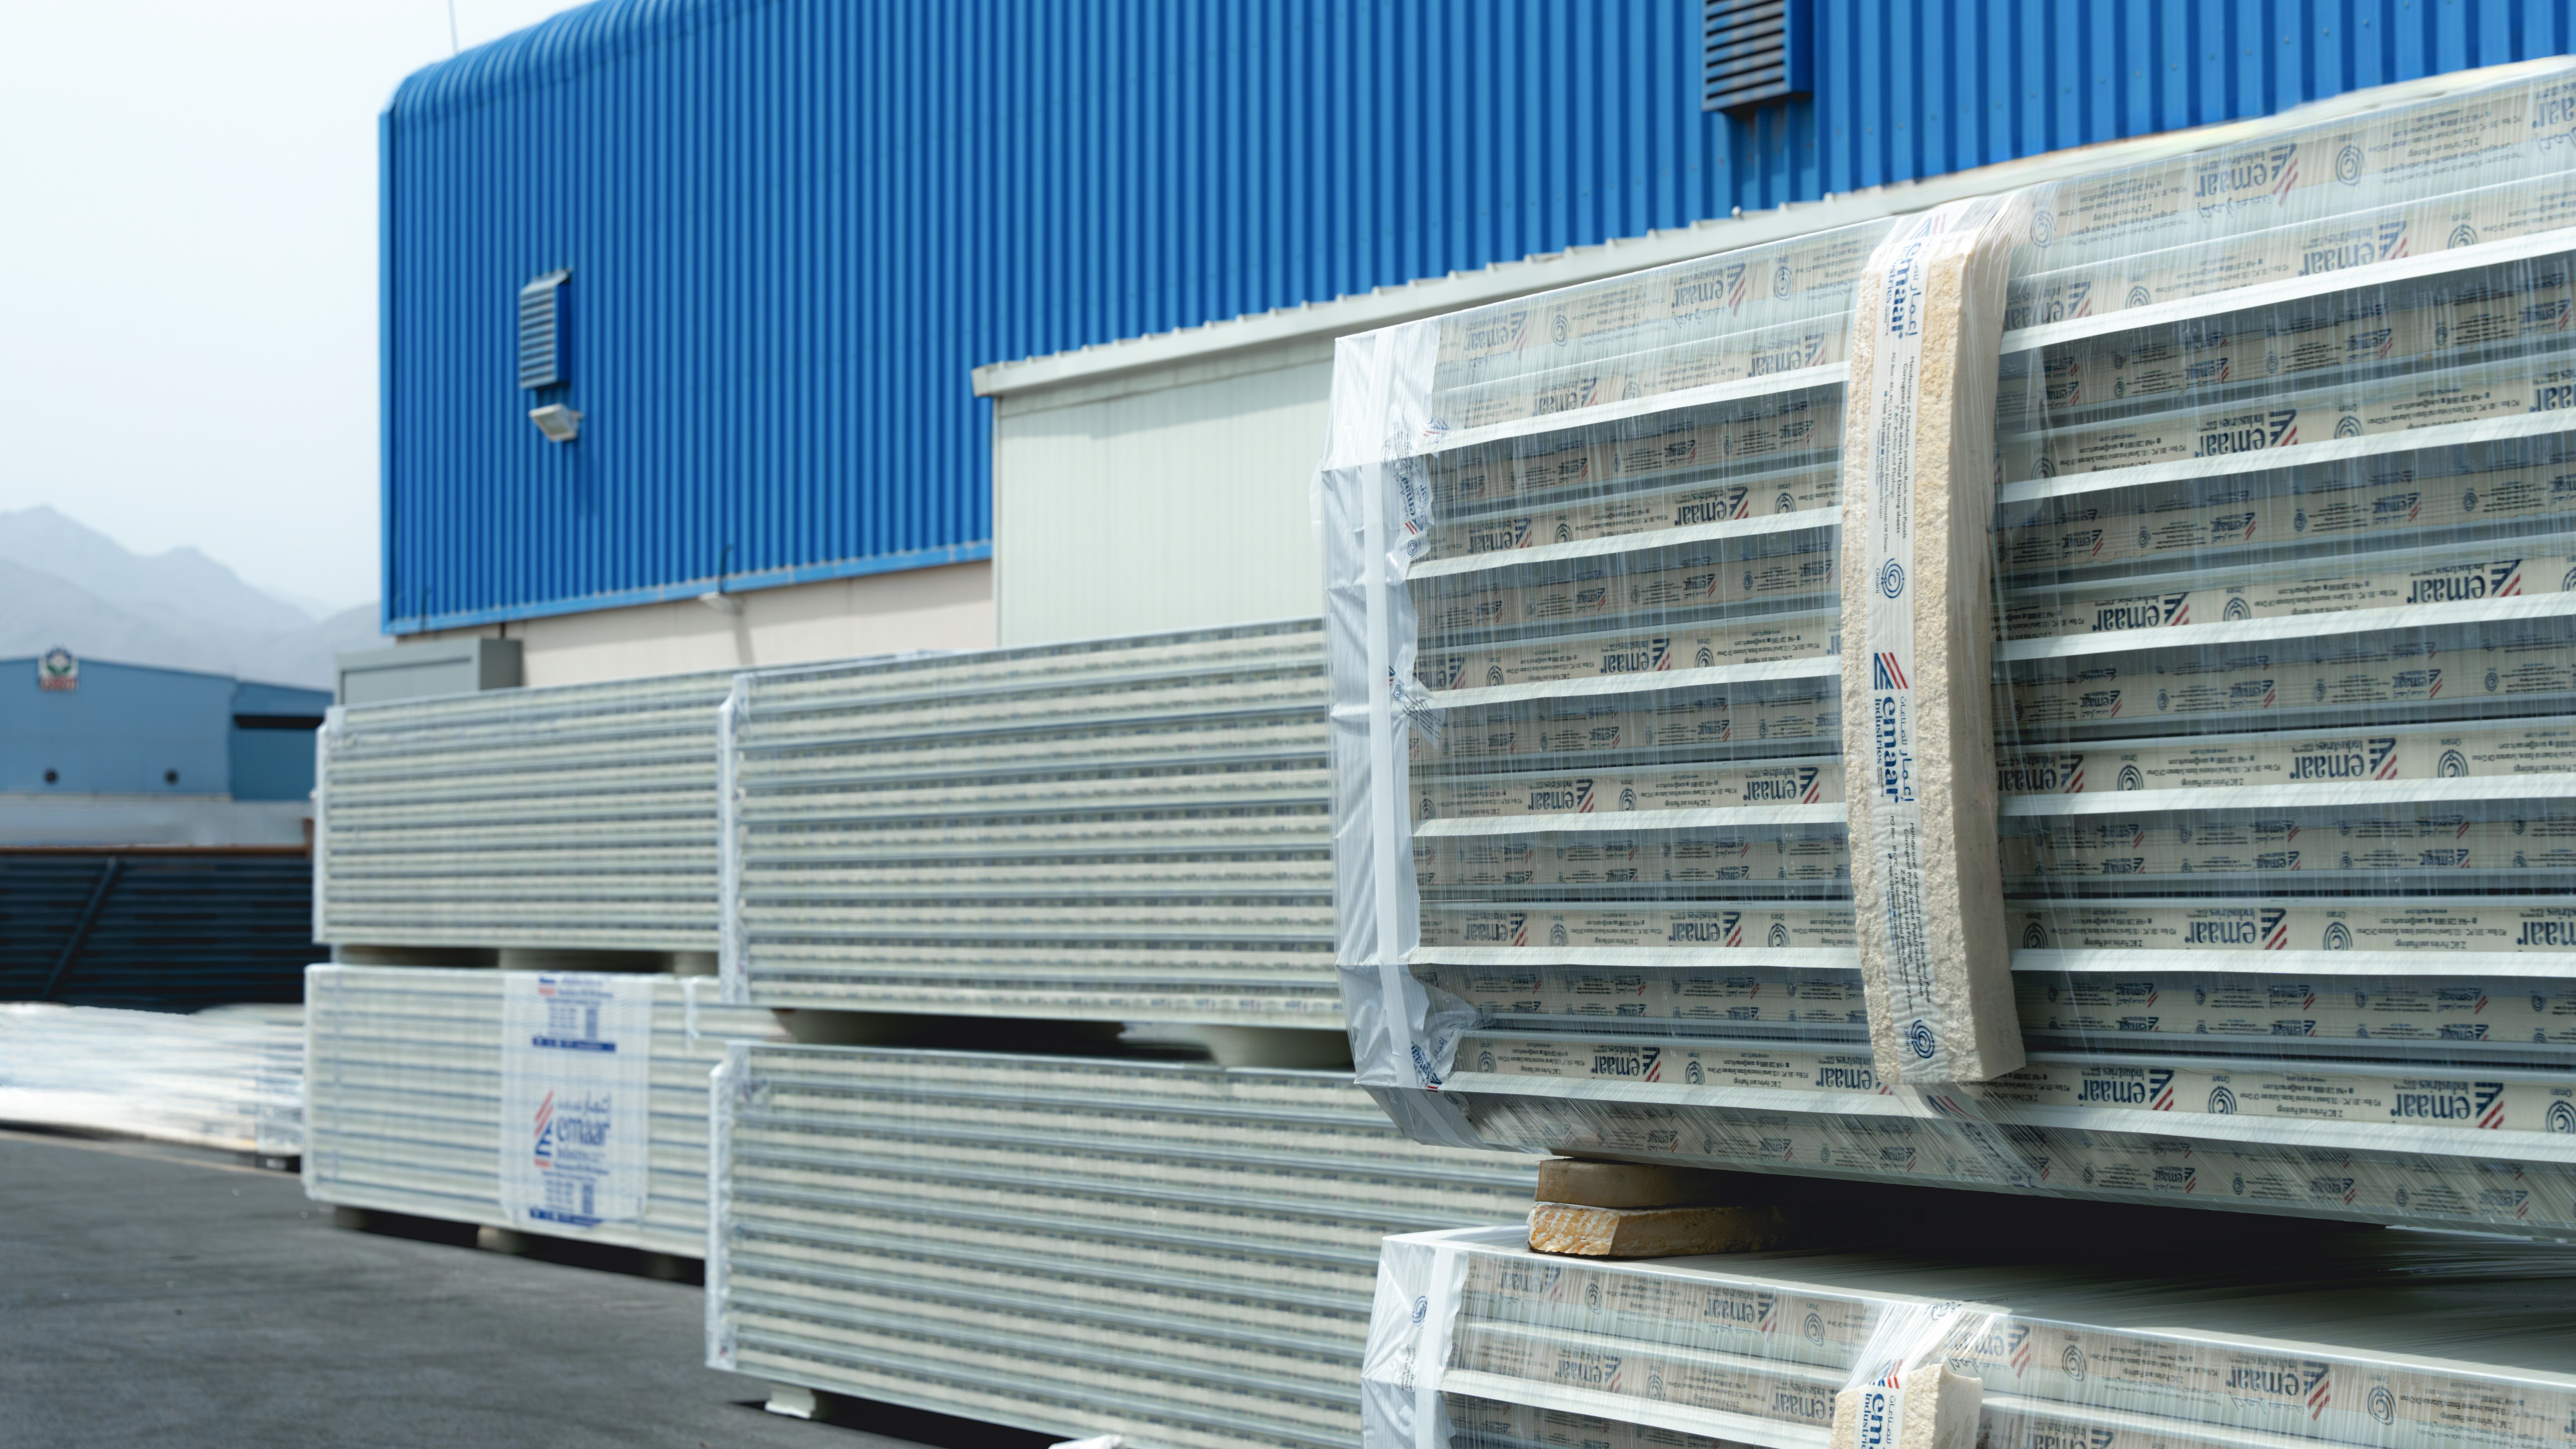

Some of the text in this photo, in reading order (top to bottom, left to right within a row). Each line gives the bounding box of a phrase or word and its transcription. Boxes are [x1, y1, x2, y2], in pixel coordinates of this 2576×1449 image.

[2298, 242, 2375, 277] emaar
[1886, 245, 1910, 303] Industries
[1671, 280, 1723, 309] emaar
[1891, 242, 1922, 339] emaar
[1747, 351, 1801, 378] emaar
[1892, 352, 1896, 362] PO
[1907, 356, 1915, 403] Manufacturer
[1889, 395, 1893, 404] PC
[2195, 428, 2266, 457] emaar
[1674, 501, 1727, 526] emaar
[1884, 524, 1888, 532] Of
[1467, 530, 1513, 554] emaar
[2406, 575, 2485, 604] emaar
[2093, 606, 2160, 632] emaar
[1599, 652, 1649, 674] emaar
[1874, 699, 1883, 764] Industries
[1883, 696, 1899, 803] emaar
[2316, 740, 2363, 754] Industries
[1762, 767, 1795, 779] Industries
[1899, 749, 1914, 802] إعمار
[2290, 754, 2363, 780] emaar
[1743, 780, 1797, 803] emaar
[1997, 769, 2057, 793] emaar
[1528, 791, 1574, 810] emaar
[1890, 816, 1895, 826] PO
[1893, 858, 1898, 867] PC
[2209, 908, 2255, 921] Industries
[1668, 922, 1719, 943] emaar
[2185, 922, 2256, 945] emaar
[1607, 1046, 1639, 1056] Industries
[1590, 1055, 1640, 1077] emaar
[2103, 1067, 2145, 1080] Industries
[1815, 1067, 1872, 1091] emaar
[2077, 1079, 2145, 1103] emaar
[2212, 1076, 2230, 1084] Omani
[2418, 1080, 2469, 1094] Industries
[2391, 1093, 2470, 1121] emaar
[557, 1117, 610, 1147] emaar
[1704, 1298, 1754, 1322] emaar
[2226, 1367, 2300, 1397] emaar
[1771, 1392, 1825, 1419] emaar
[1869, 1393, 1885, 1449] em
[1886, 1396, 1896, 1444] للصناعات
